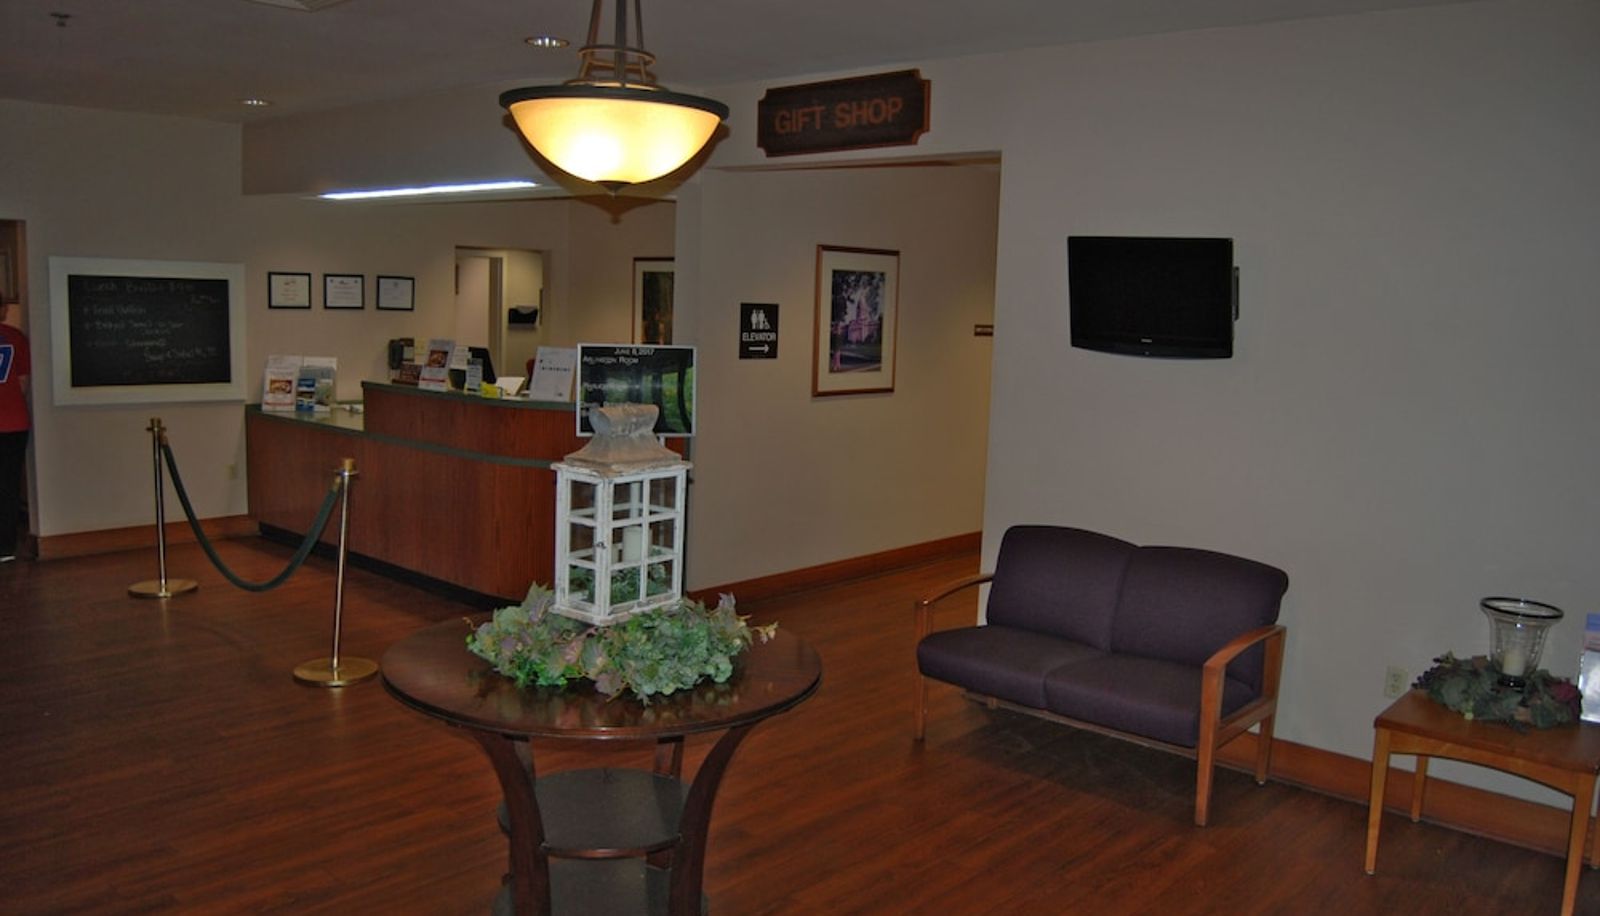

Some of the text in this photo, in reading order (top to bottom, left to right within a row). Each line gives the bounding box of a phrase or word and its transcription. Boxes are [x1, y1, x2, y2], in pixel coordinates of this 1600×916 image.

[773, 95, 904, 135] GIFT SHOP
[742, 332, 776, 342] ELEVATOR
